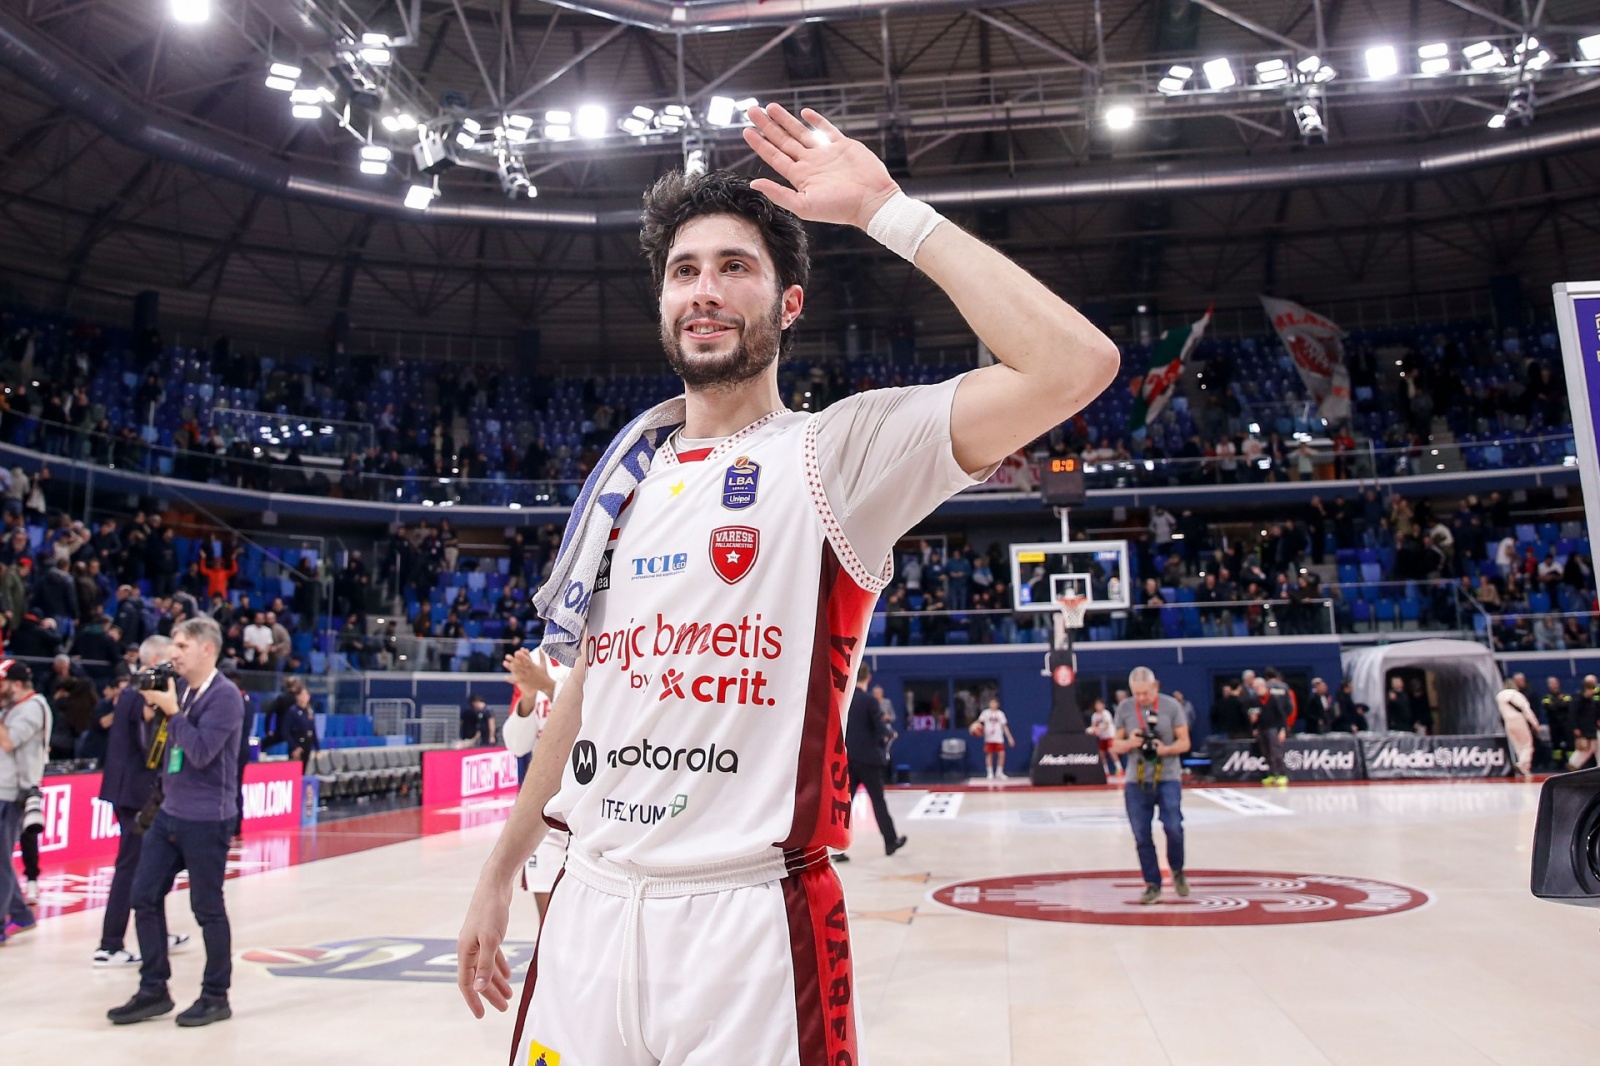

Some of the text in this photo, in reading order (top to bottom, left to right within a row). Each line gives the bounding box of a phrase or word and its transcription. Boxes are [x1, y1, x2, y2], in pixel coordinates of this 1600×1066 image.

[728, 476, 755, 486] LBA
[729, 494, 751, 504] Unipol
[715, 531, 755, 543] VARESE
[632, 554, 686, 576] TCI LED
[587, 613, 783, 671] penjobmetis
[630, 668, 776, 707] by crit.
